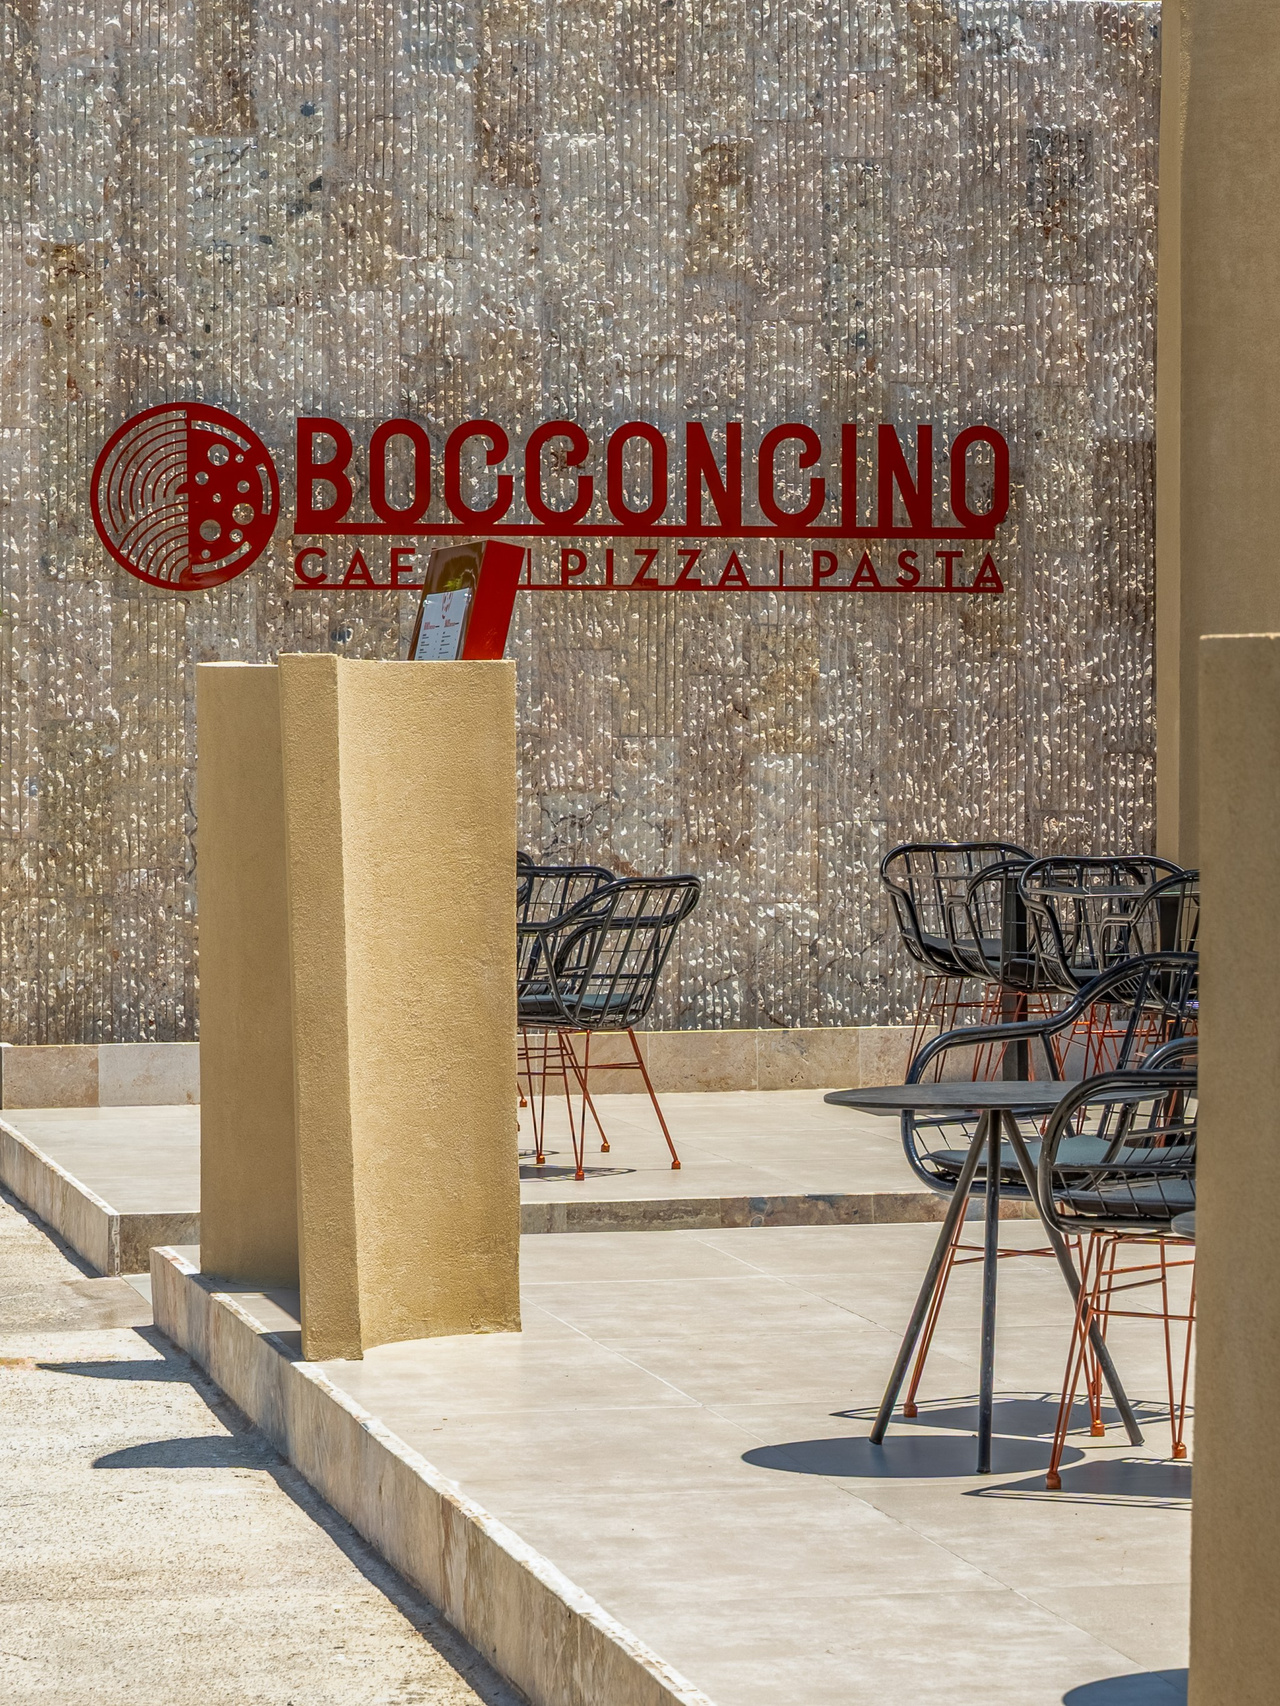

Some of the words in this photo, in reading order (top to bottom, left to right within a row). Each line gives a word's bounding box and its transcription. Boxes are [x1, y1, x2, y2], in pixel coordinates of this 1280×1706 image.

[296, 417, 1010, 538] BOCCONCINO
[561, 548, 750, 590] PIZZA
[812, 550, 1003, 592] PASTA
